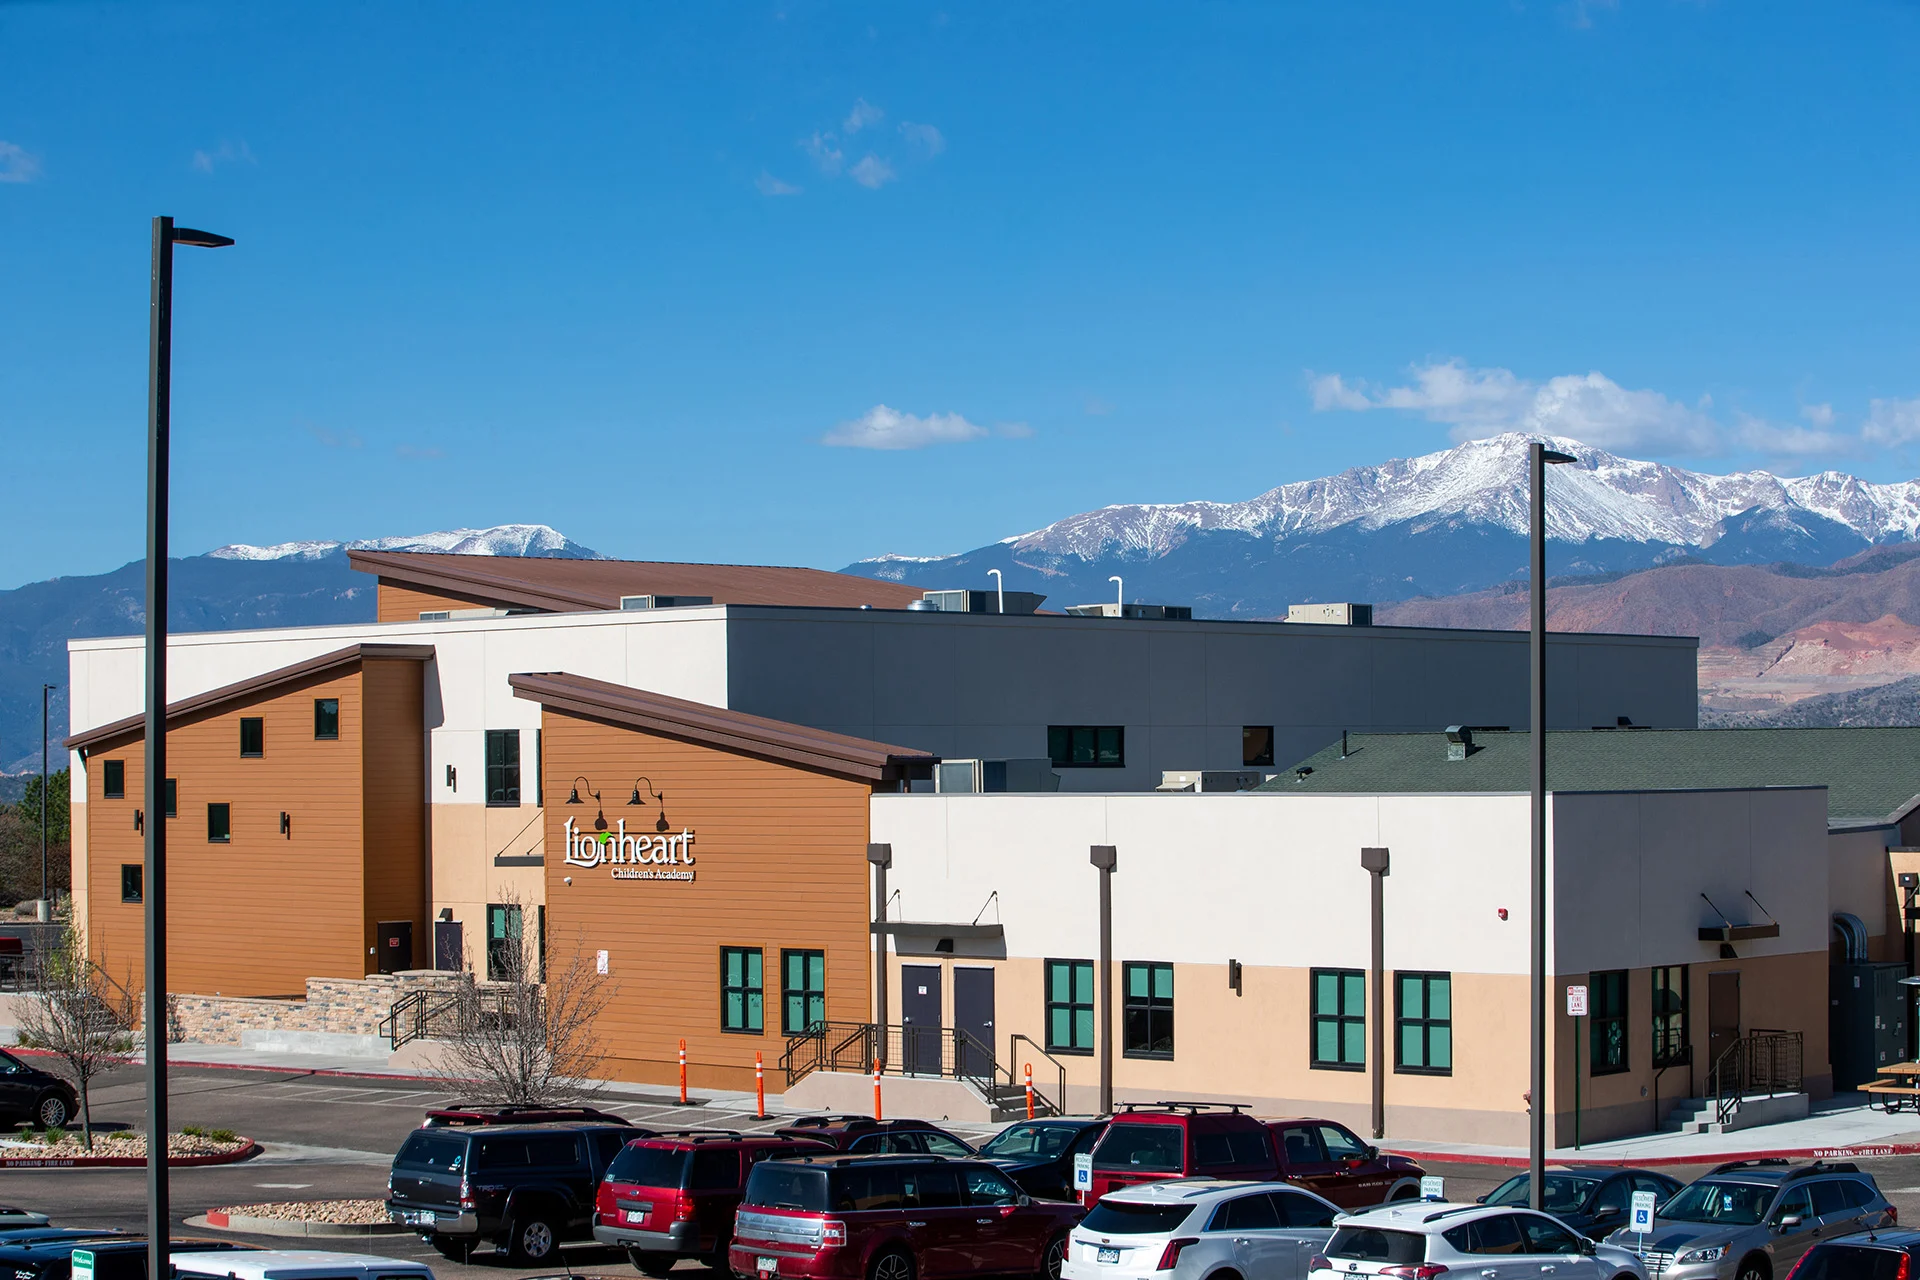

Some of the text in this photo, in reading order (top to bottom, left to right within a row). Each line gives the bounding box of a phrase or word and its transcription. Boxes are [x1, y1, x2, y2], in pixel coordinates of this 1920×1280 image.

[563, 816, 694, 867] Lionheart
[611, 867, 694, 882] Children's Academy
[1824, 1149, 1855, 1157] PARKING
